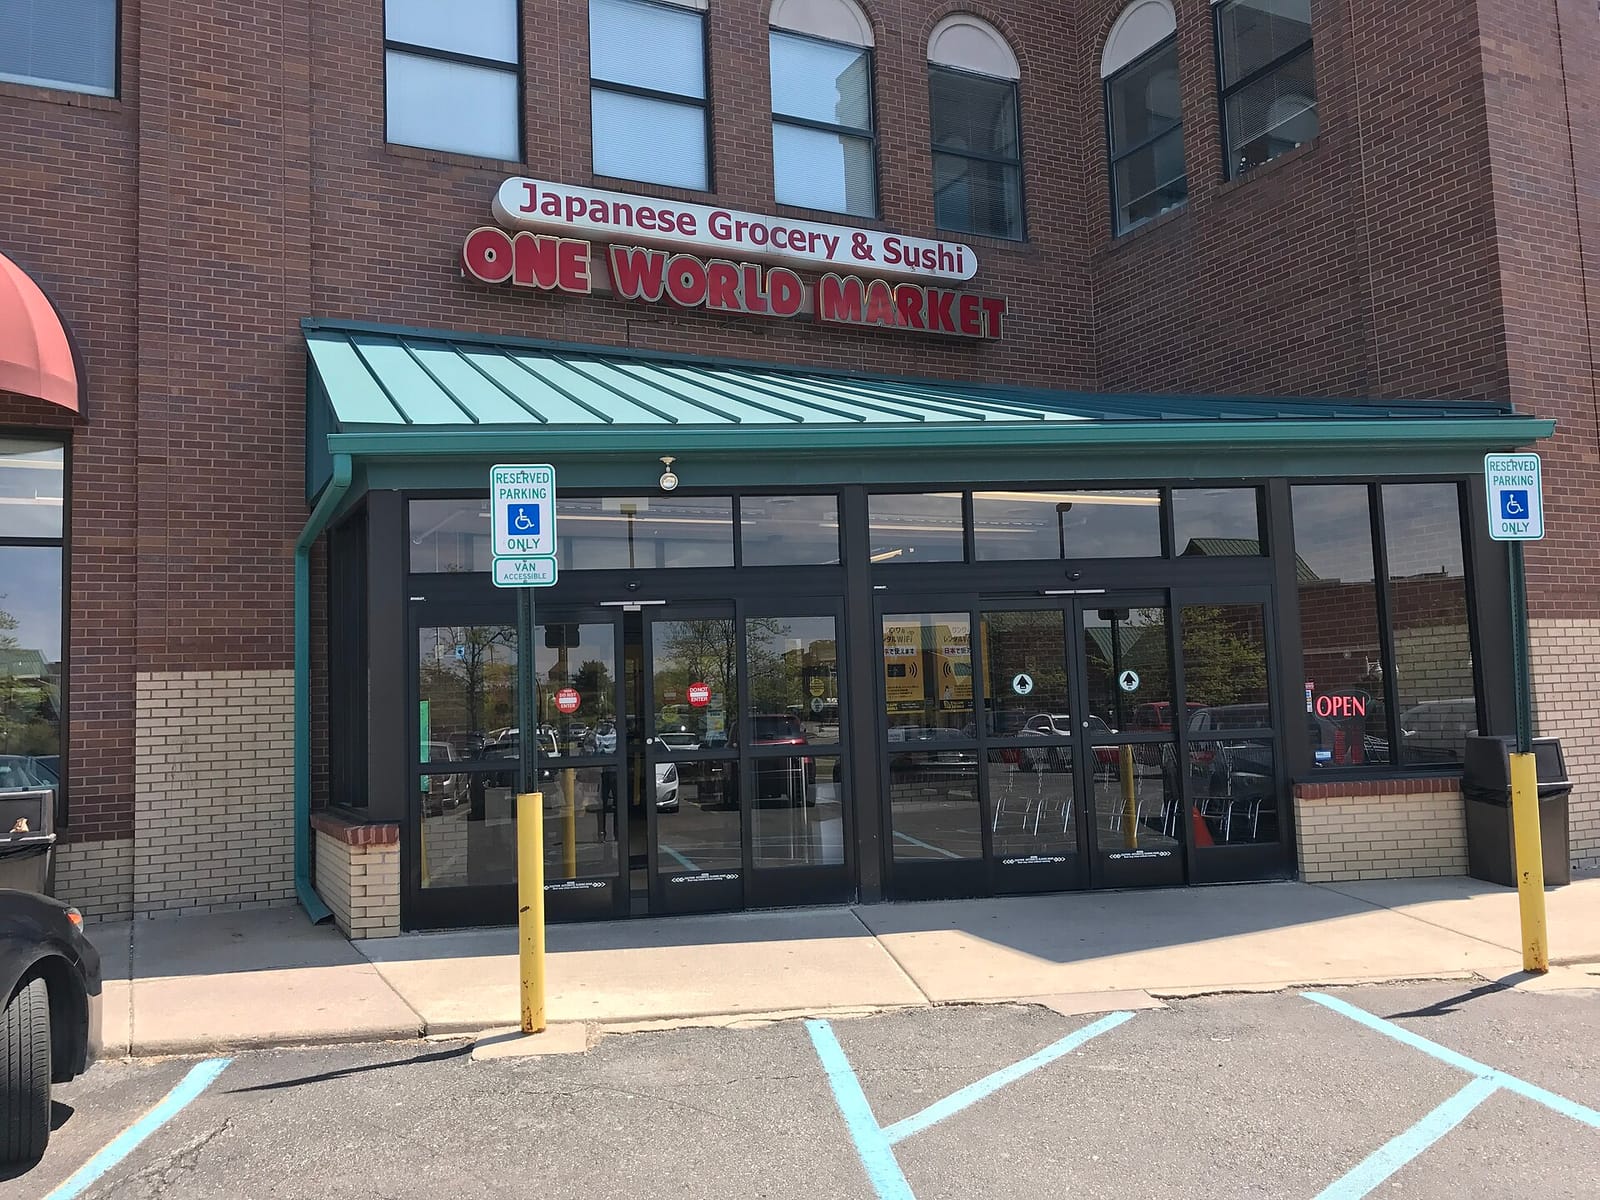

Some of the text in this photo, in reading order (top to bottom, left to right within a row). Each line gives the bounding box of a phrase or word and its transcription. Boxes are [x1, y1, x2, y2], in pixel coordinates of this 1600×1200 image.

[519, 183, 963, 273] Japanese Grocery & Sushi
[464, 227, 1008, 339] ONE WORLD MARKET
[1490, 461, 1536, 471] RESERVED
[496, 472, 550, 484] RESERVED
[1493, 475, 1534, 486] PARKING
[500, 488, 547, 500] PARKING
[1501, 522, 1530, 532] ONLY
[507, 538, 541, 550] ONLY
[514, 562, 536, 572] VAN
[1316, 695, 1366, 717] OPEN
